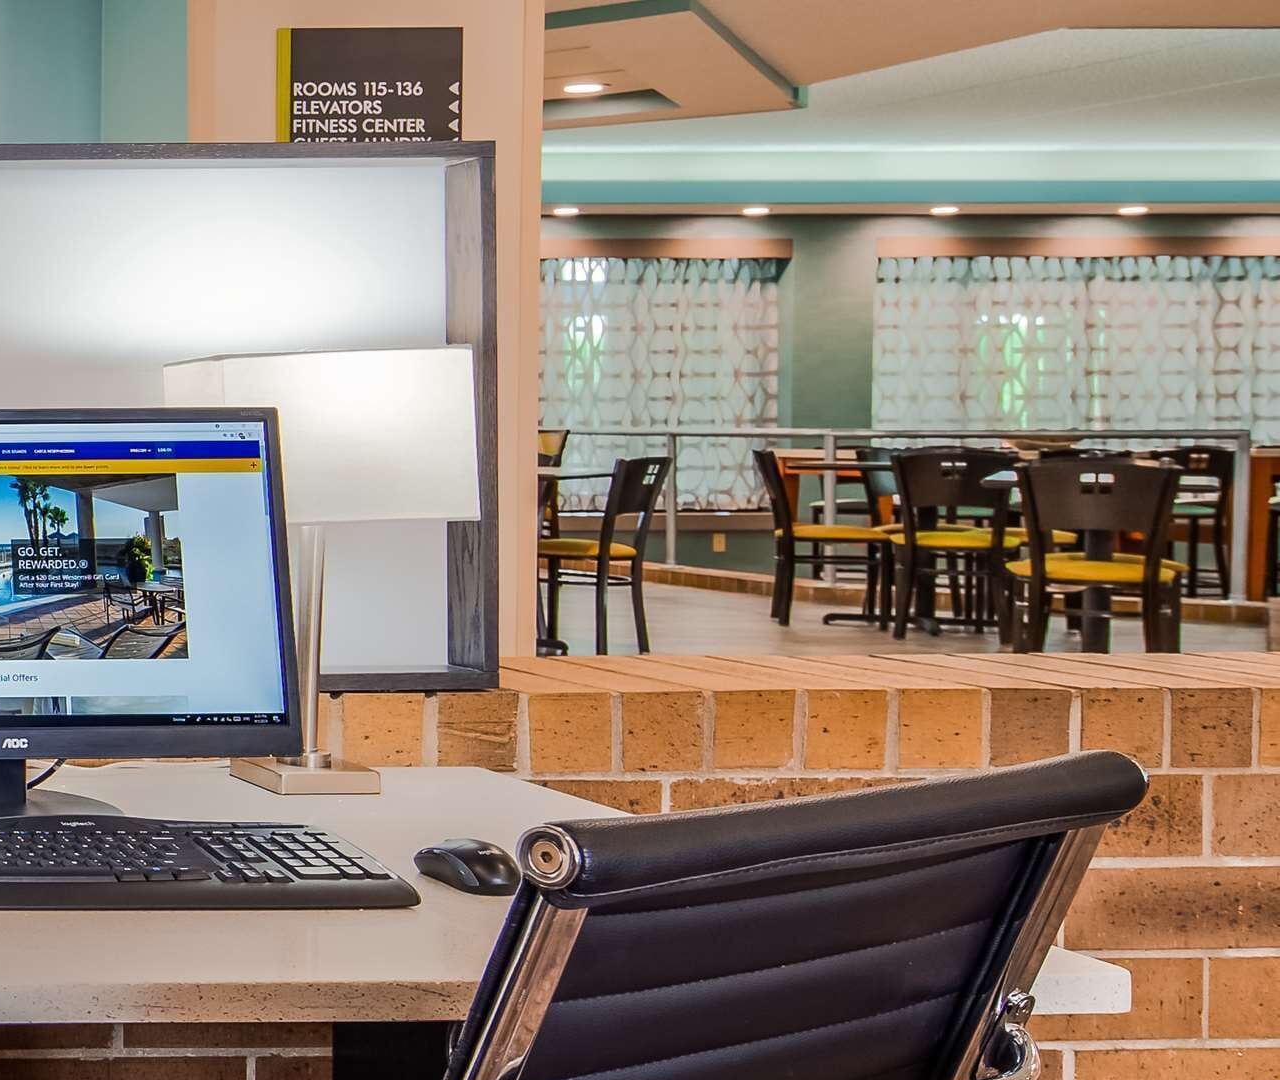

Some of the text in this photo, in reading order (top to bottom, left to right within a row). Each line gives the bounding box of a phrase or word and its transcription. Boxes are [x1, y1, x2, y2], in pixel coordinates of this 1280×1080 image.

[293, 81, 424, 97] ROOMS 115-136
[293, 100, 383, 115] ELEVATORS
[293, 118, 426, 133] FITNESS CENTER
[17, 547, 63, 557] GO. GET.
[12, 673, 39, 682] Offers
[1, 738, 29, 749] AOC
